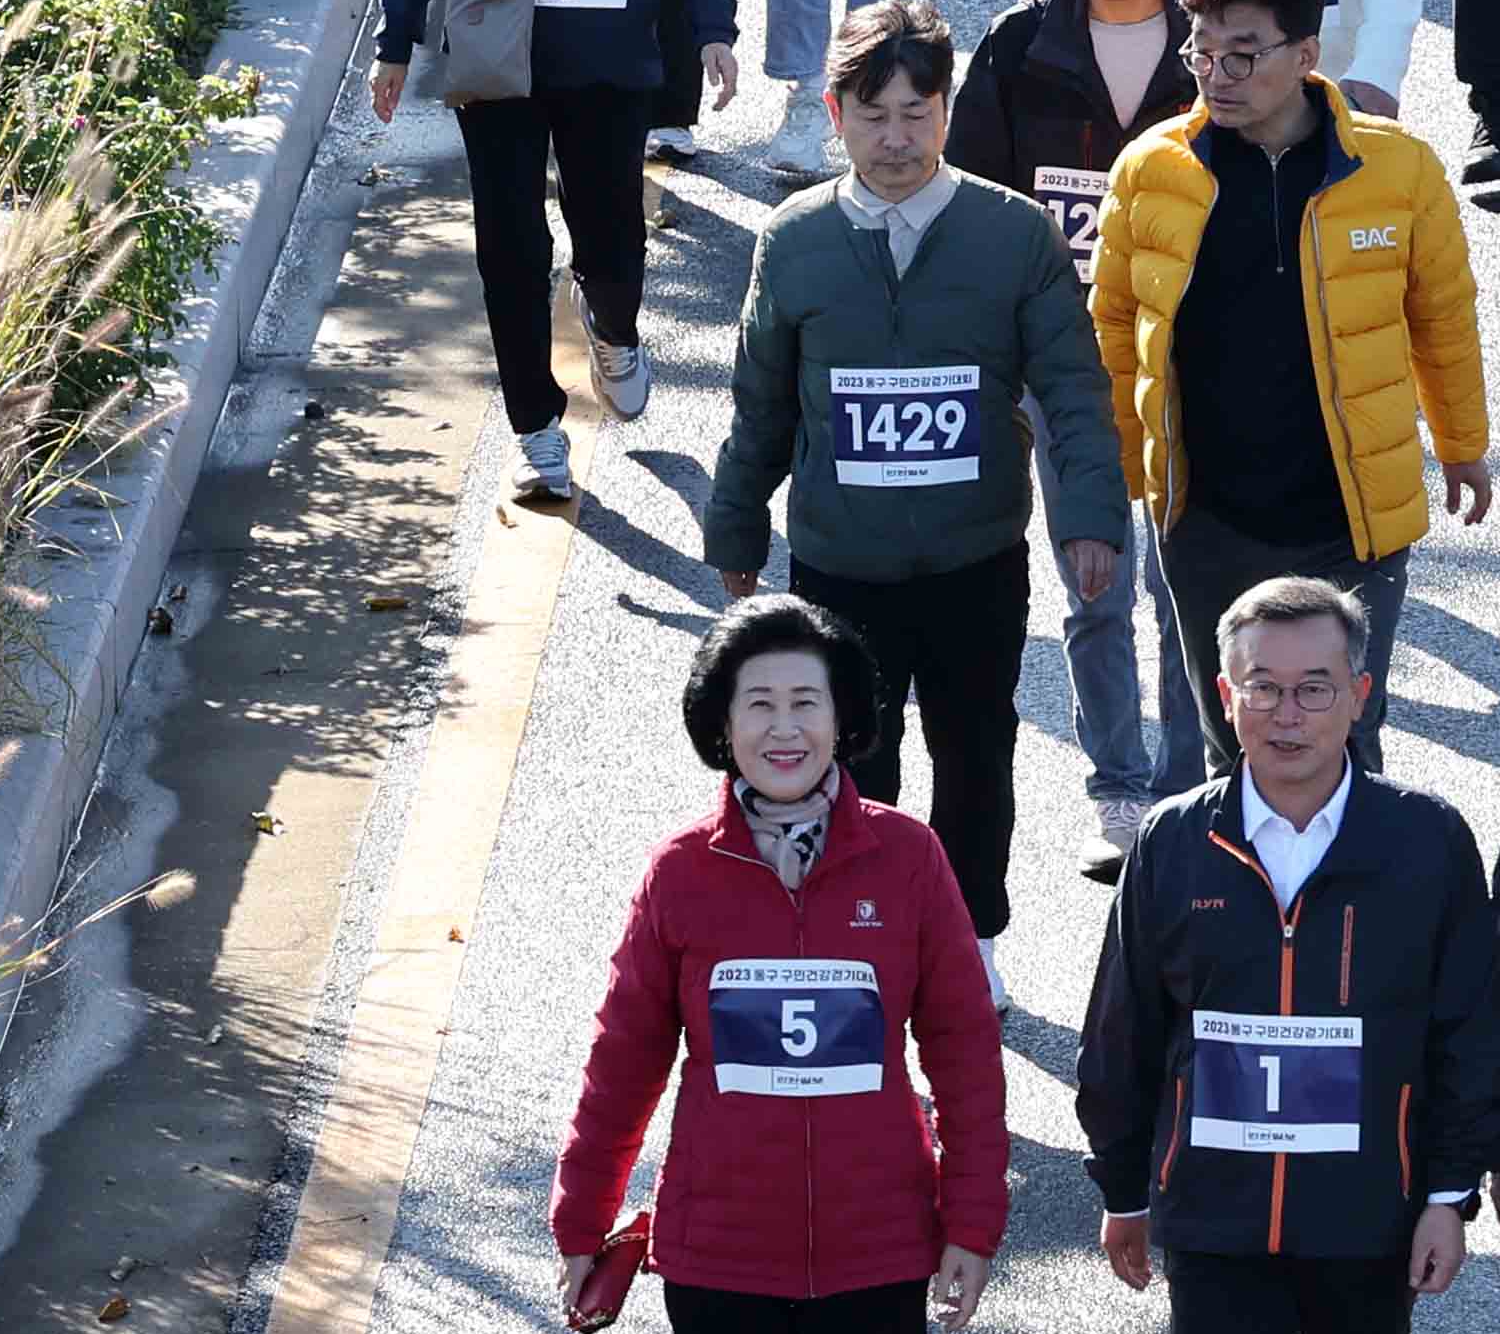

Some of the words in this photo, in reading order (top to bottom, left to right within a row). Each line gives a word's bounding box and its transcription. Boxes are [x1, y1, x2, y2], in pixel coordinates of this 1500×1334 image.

[1041, 173, 1069, 186] 2023
[1348, 227, 1398, 250] BAC
[837, 376, 864, 388] 2023
[844, 399, 967, 452] 1429
[717, 968, 750, 981] 2023
[780, 999, 818, 1058] 5
[1202, 1019, 1230, 1035] 2023
[1259, 1055, 1281, 1113] 1
